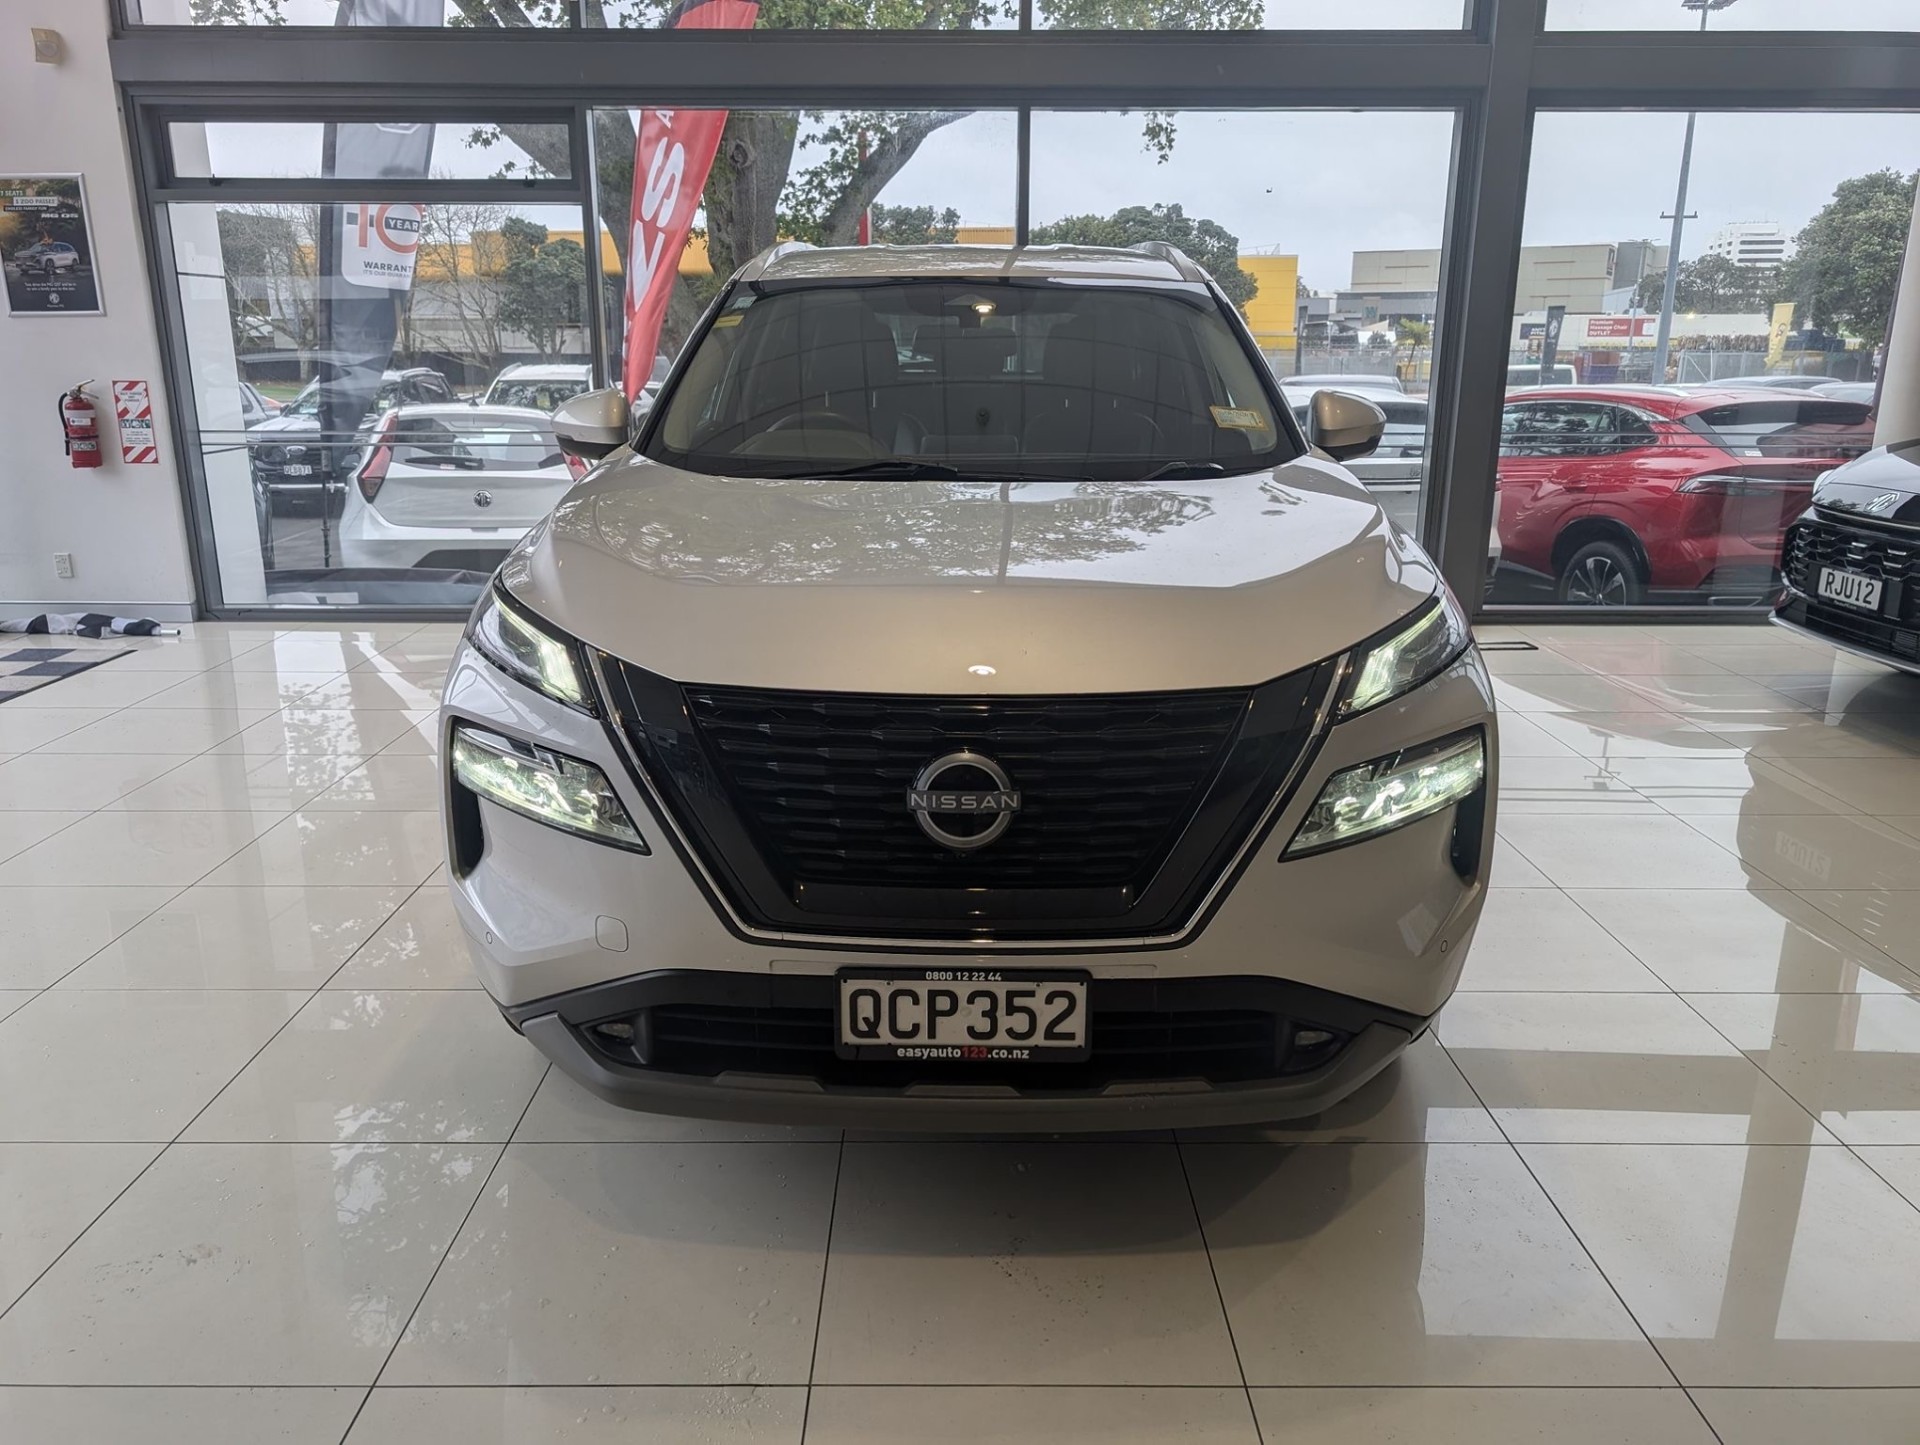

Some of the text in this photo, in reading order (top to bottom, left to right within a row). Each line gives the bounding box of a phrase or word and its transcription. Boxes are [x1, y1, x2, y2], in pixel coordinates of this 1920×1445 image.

[388, 218, 419, 231] YEAR
[363, 261, 413, 273] WARRANT
[1824, 571, 1876, 605] RJU12
[911, 793, 1018, 809] NISSAN
[925, 971, 1002, 982] 0800 12 22 44
[849, 989, 1077, 1041] QCP352
[897, 1047, 1030, 1060] easyauto123.co.nz
